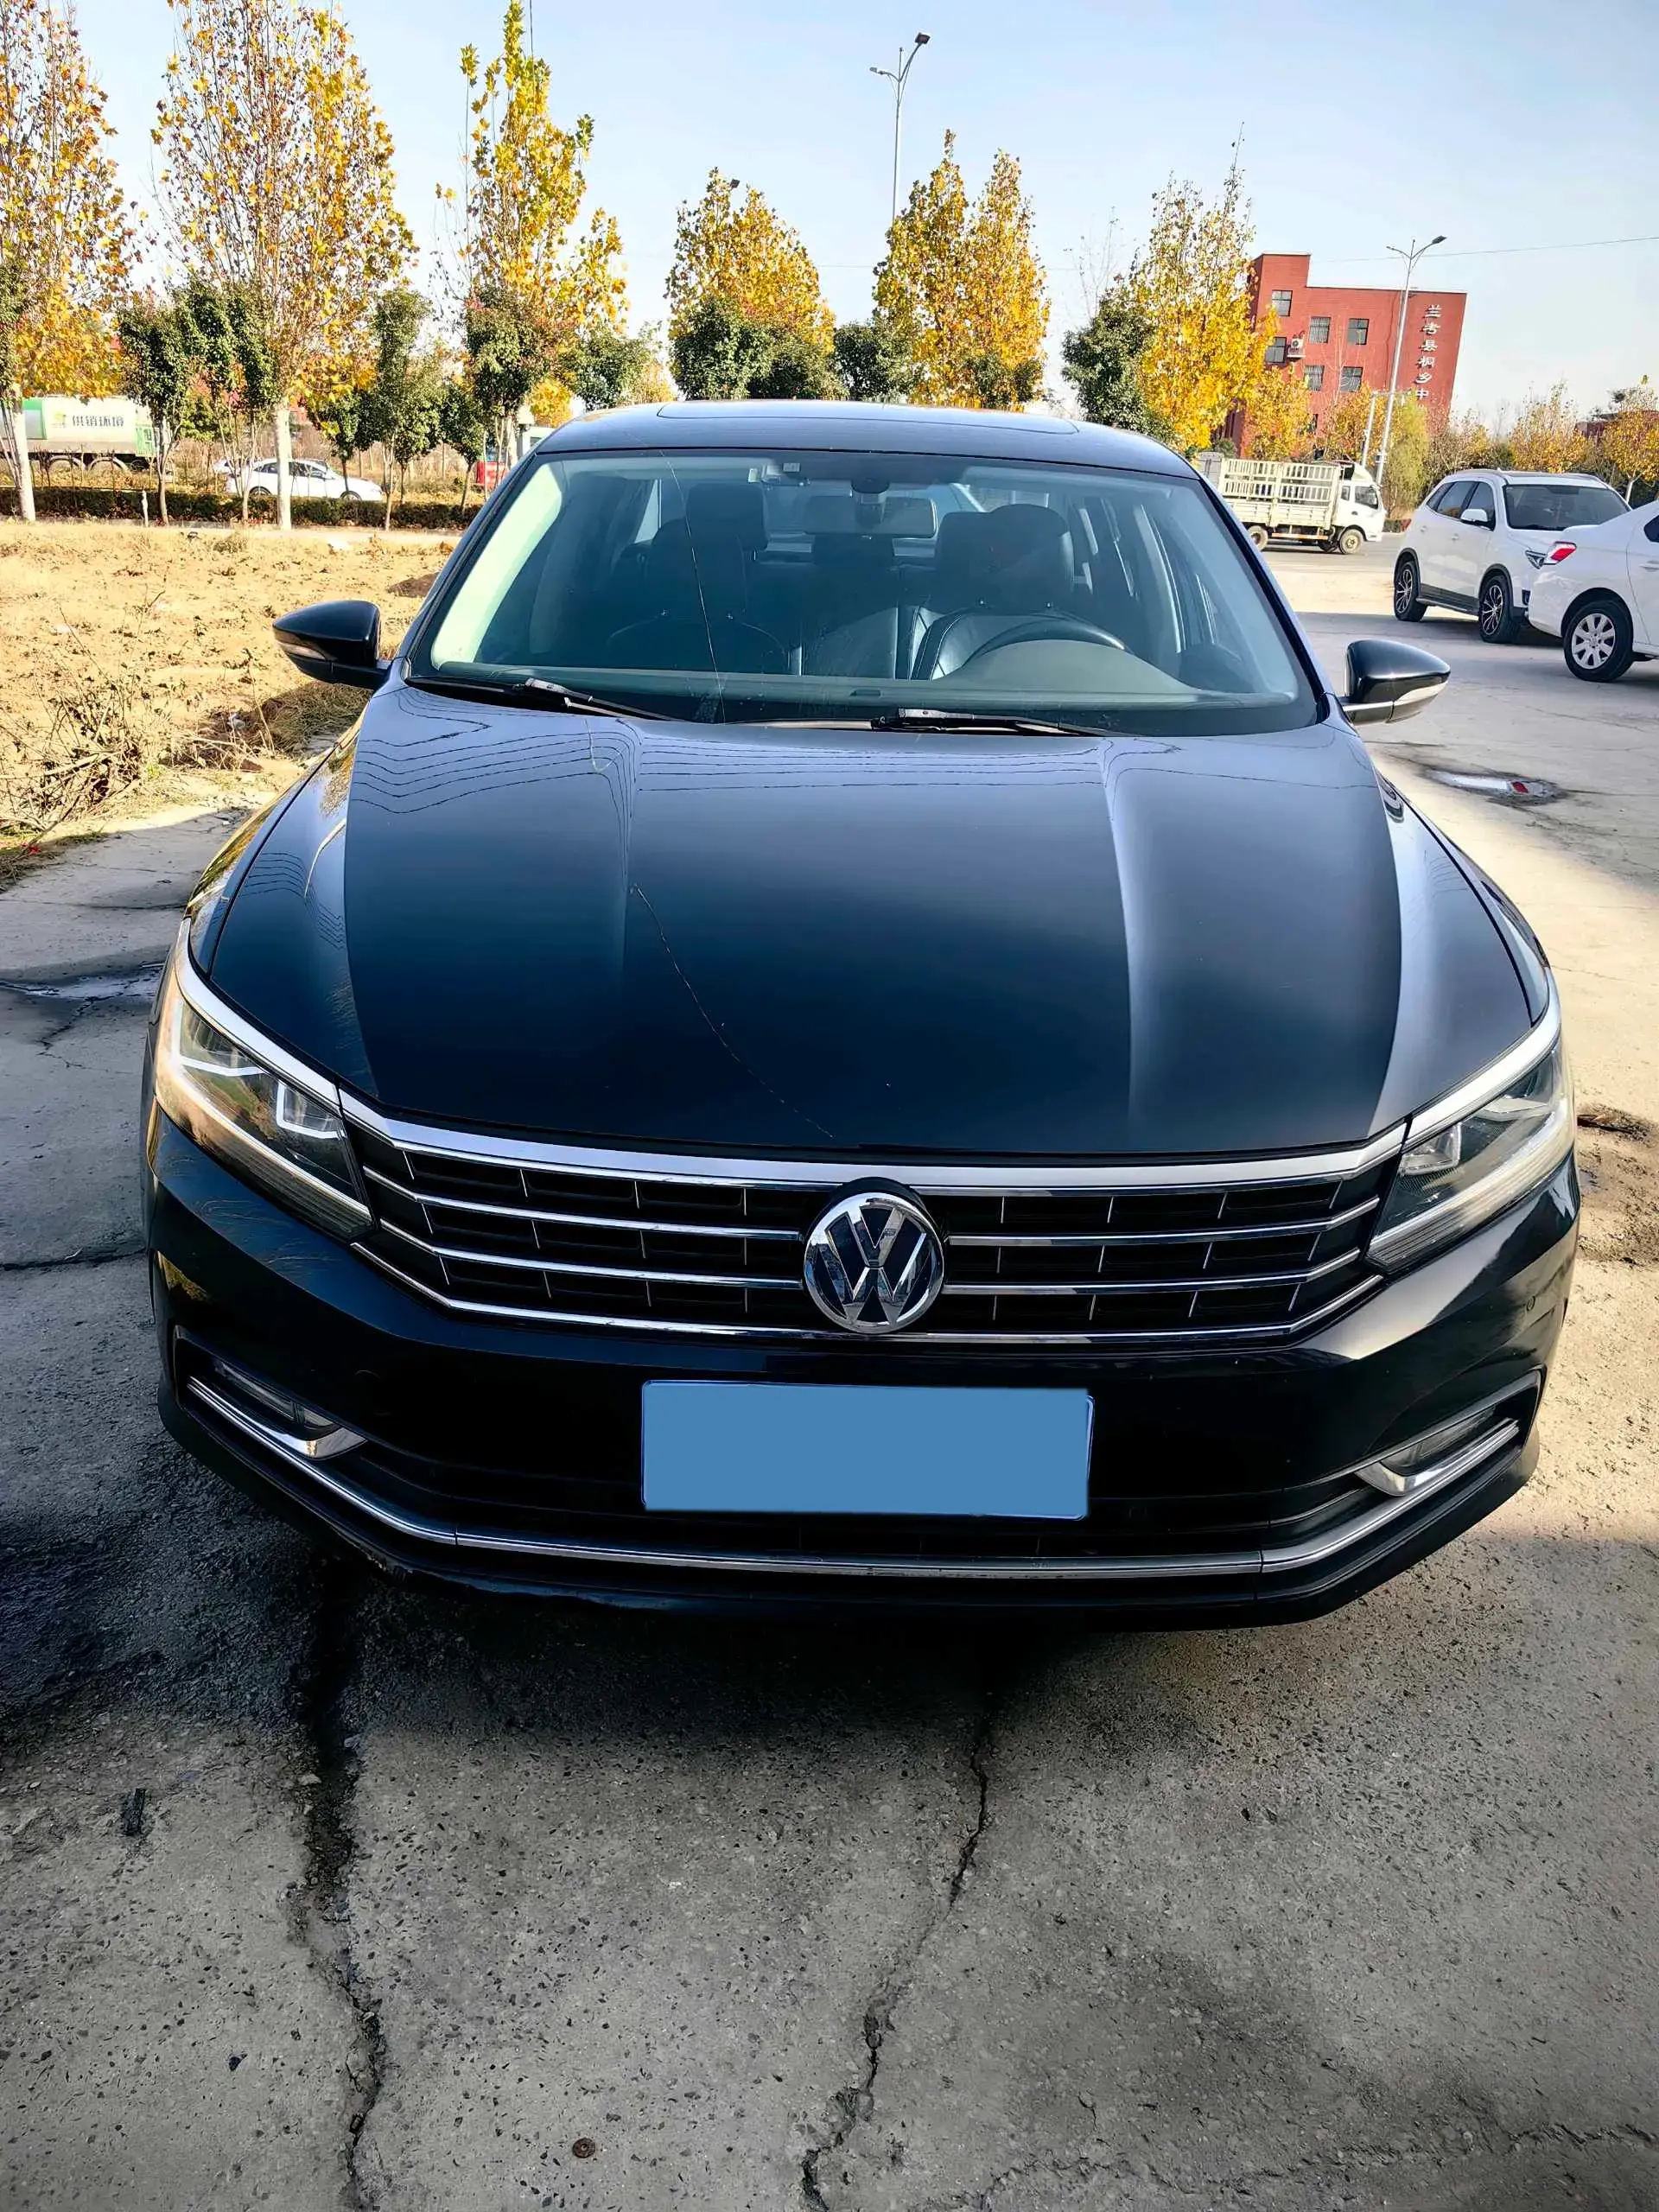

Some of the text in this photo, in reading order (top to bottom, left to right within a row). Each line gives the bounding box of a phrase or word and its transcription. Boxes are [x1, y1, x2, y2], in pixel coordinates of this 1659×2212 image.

[1414, 304, 1442, 407] 兰考县桐乡中
[810, 1195, 937, 1331] VW
